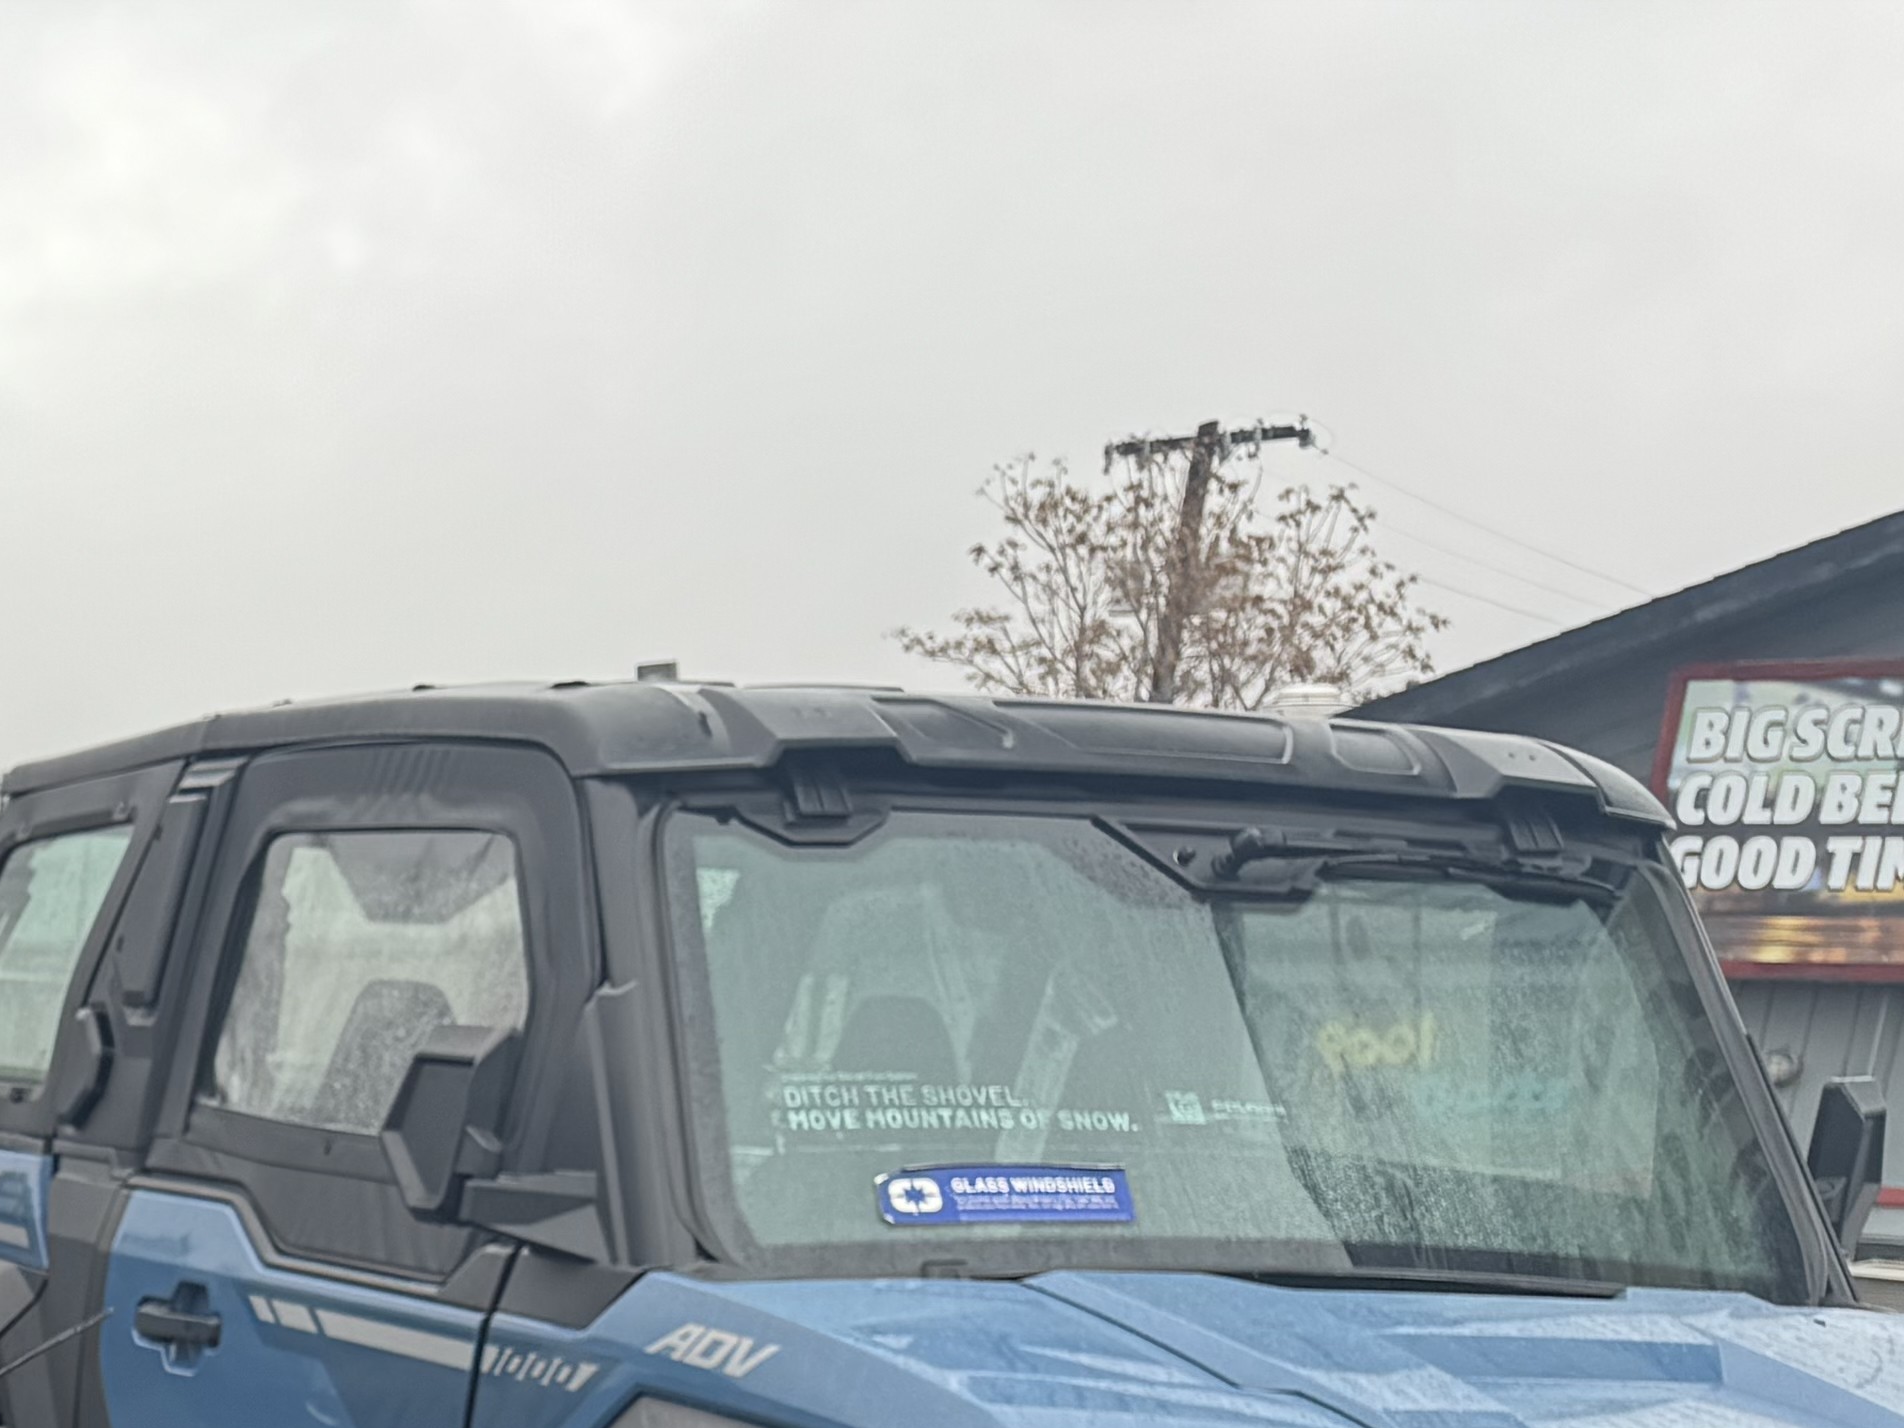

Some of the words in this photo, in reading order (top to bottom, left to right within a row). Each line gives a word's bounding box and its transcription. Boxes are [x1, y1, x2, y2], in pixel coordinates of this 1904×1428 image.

[1687, 705, 1787, 762] BIG
[1788, 704, 1904, 762] SCR
[1676, 771, 1816, 826] COLD
[1670, 835, 1817, 891] GOOD
[784, 1085, 859, 1108] DITCH
[864, 1085, 914, 1107] THE
[788, 1109, 861, 1131] MOVE
[864, 1109, 1015, 1130] MOUNTAINS
[1020, 1109, 1048, 1130] OF
[950, 1176, 1010, 1194] GLASS
[1010, 1176, 1116, 1194] WINDSHIELD
[644, 1322, 780, 1378] ADV
